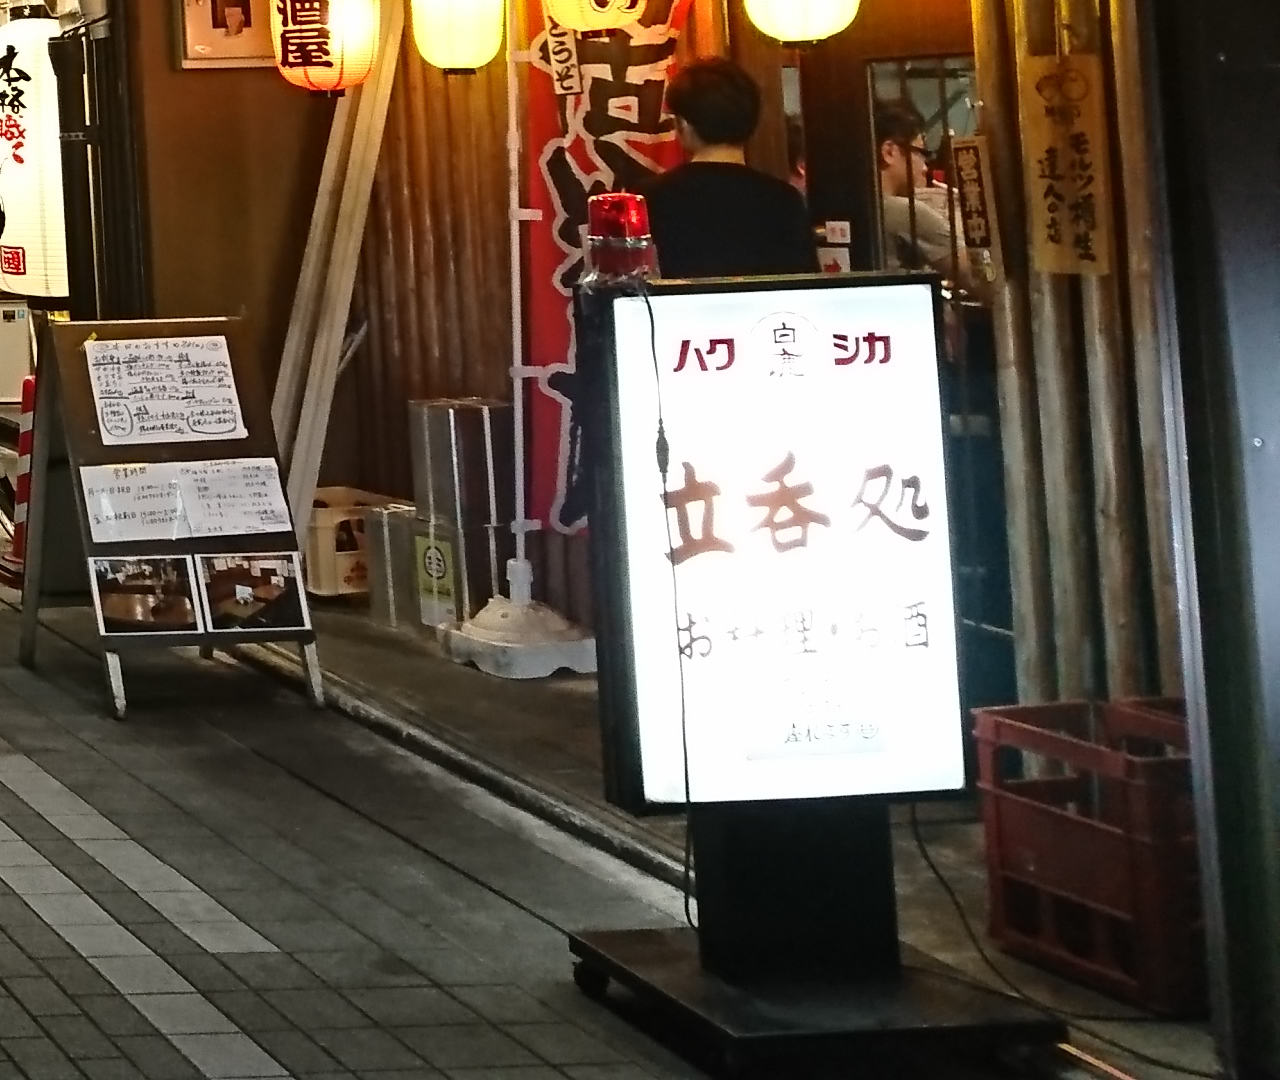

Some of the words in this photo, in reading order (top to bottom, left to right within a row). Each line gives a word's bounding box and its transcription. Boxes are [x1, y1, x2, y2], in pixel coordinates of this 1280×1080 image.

[674, 338, 736, 372] ハク
[832, 332, 892, 366] シカ
[660, 450, 930, 566] 立呑処
